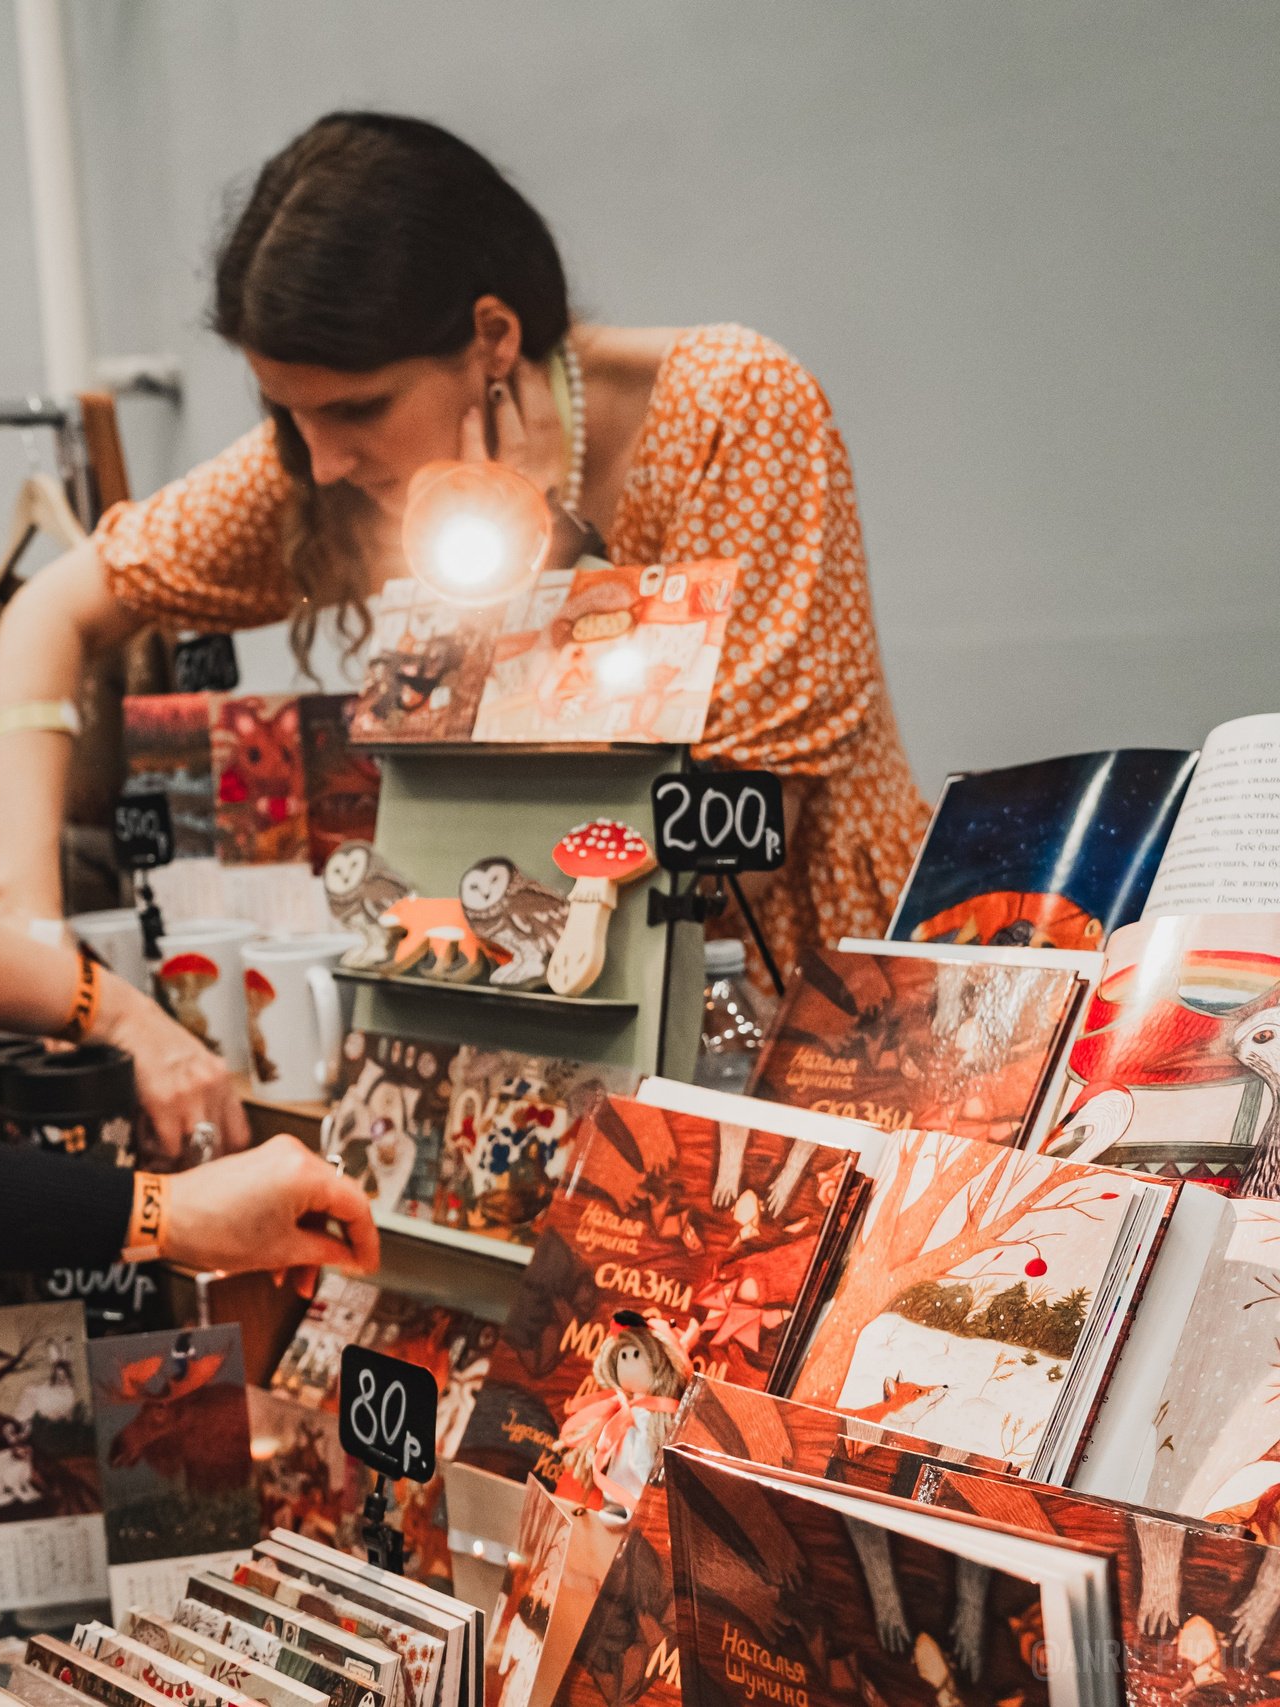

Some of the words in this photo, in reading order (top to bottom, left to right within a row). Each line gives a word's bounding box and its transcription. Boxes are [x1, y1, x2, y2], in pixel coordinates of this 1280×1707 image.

[1216, 894, 1254, 906] Почему
[789, 1046, 858, 1074] Наталья
[580, 1200, 645, 1238] Наталья
[575, 1222, 640, 1255] Шунина
[594, 1262, 693, 1312] СКАЗКИ
[722, 1621, 806, 1685] Наталья
[725, 1653, 809, 1707] Шунина
